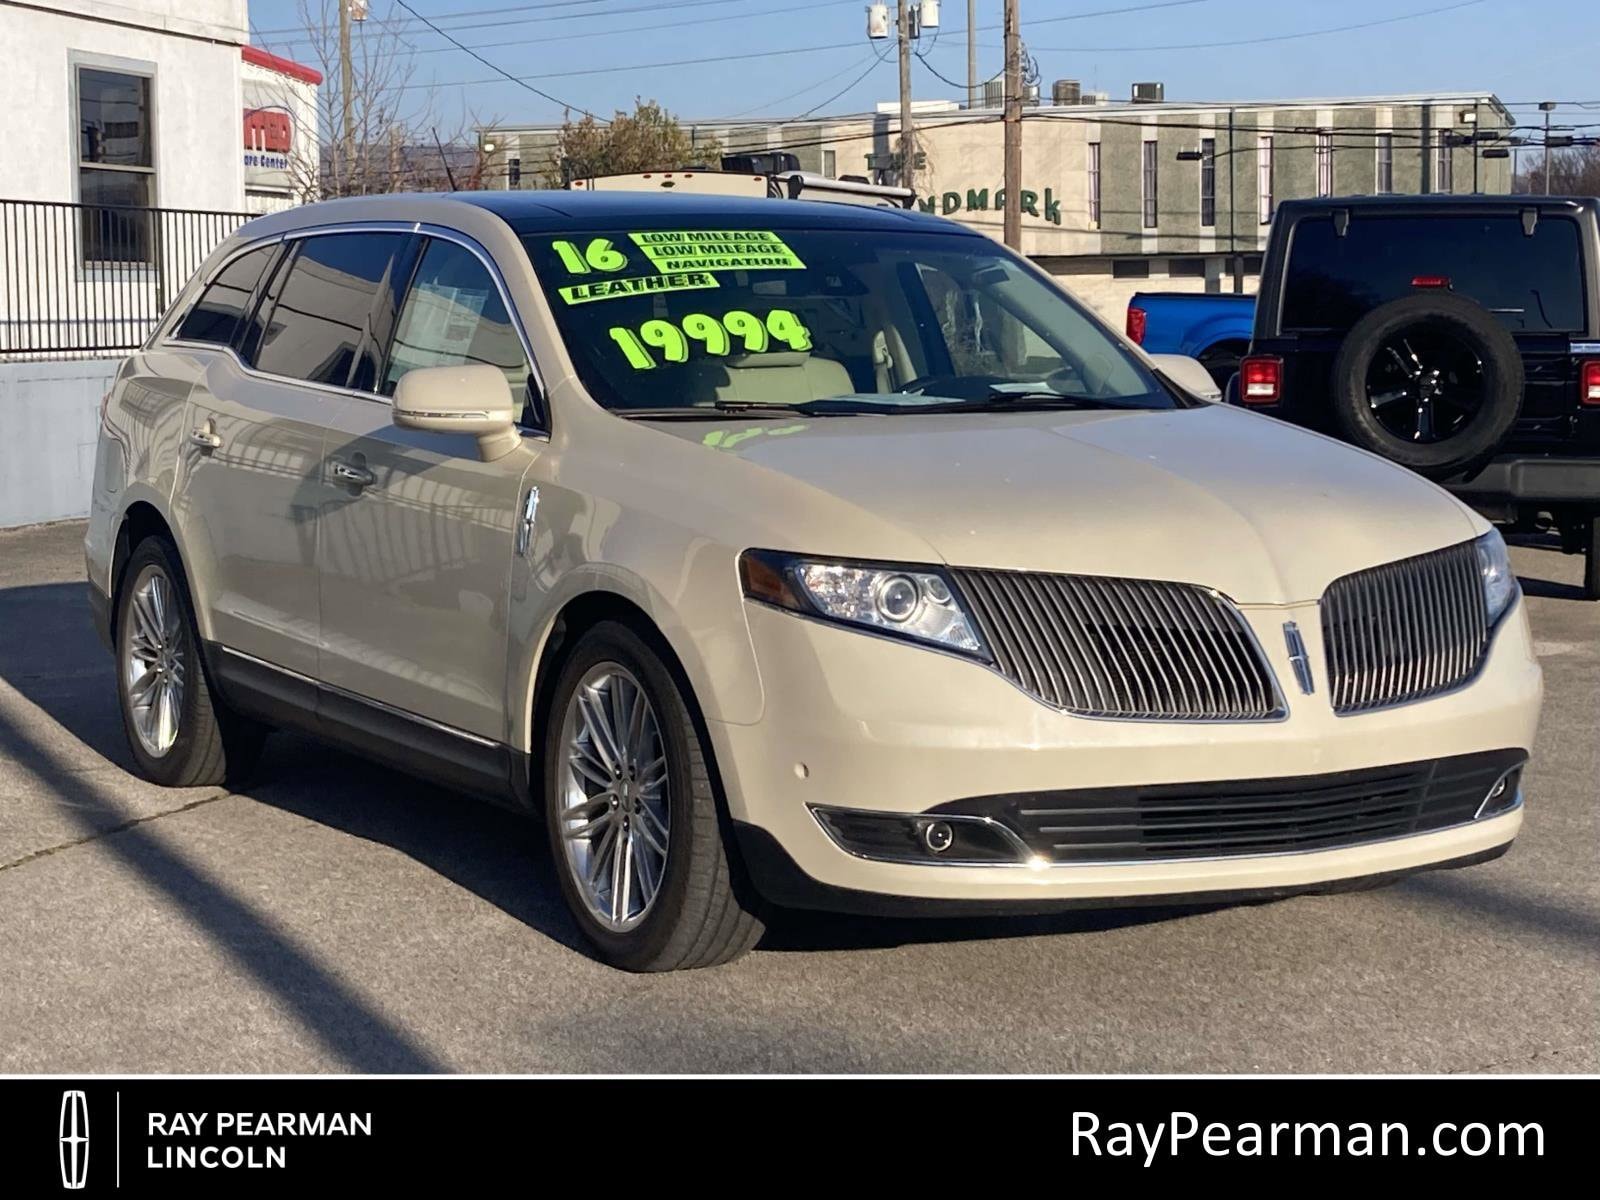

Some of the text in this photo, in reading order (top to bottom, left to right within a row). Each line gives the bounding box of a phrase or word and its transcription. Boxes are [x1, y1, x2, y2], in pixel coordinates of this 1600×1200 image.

[260, 155, 288, 168] Center
[641, 232, 771, 243] LOW MILEAGE
[552, 238, 628, 274] 16
[653, 244, 786, 257] LOW MILEAGE
[666, 258, 791, 270] NAVIGATION
[571, 273, 709, 300] LEATHER
[609, 309, 813, 369] 19994
